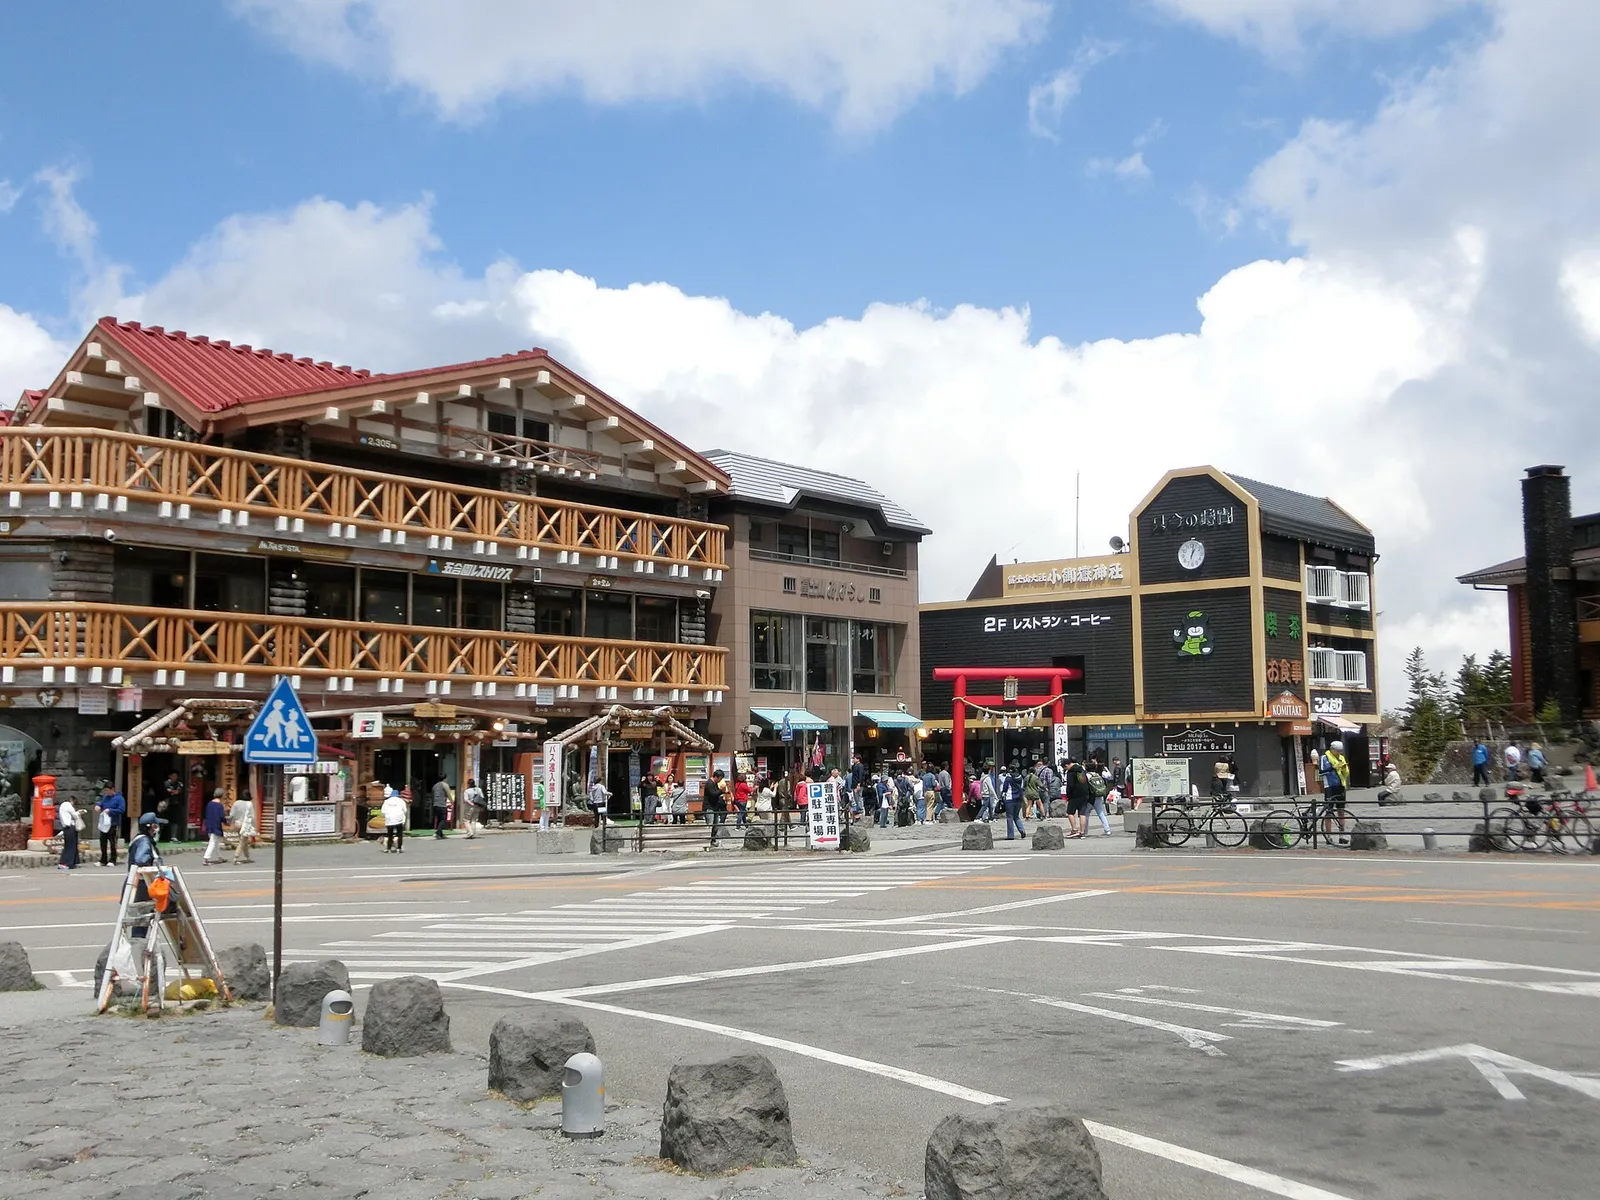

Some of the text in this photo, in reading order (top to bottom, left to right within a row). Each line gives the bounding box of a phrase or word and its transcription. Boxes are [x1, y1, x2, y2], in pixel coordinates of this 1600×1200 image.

[983, 613, 1111, 632] 2F レストラン・コーヒー
[1266, 658, 1302, 684] お食事
[1272, 704, 1303, 717] KOMITAKE
[1166, 743, 1186, 751] 富士山
[548, 745, 556, 803] バス進入禁止
[810, 785, 824, 836] P 駐車場
[824, 783, 837, 836] 普通車専用
